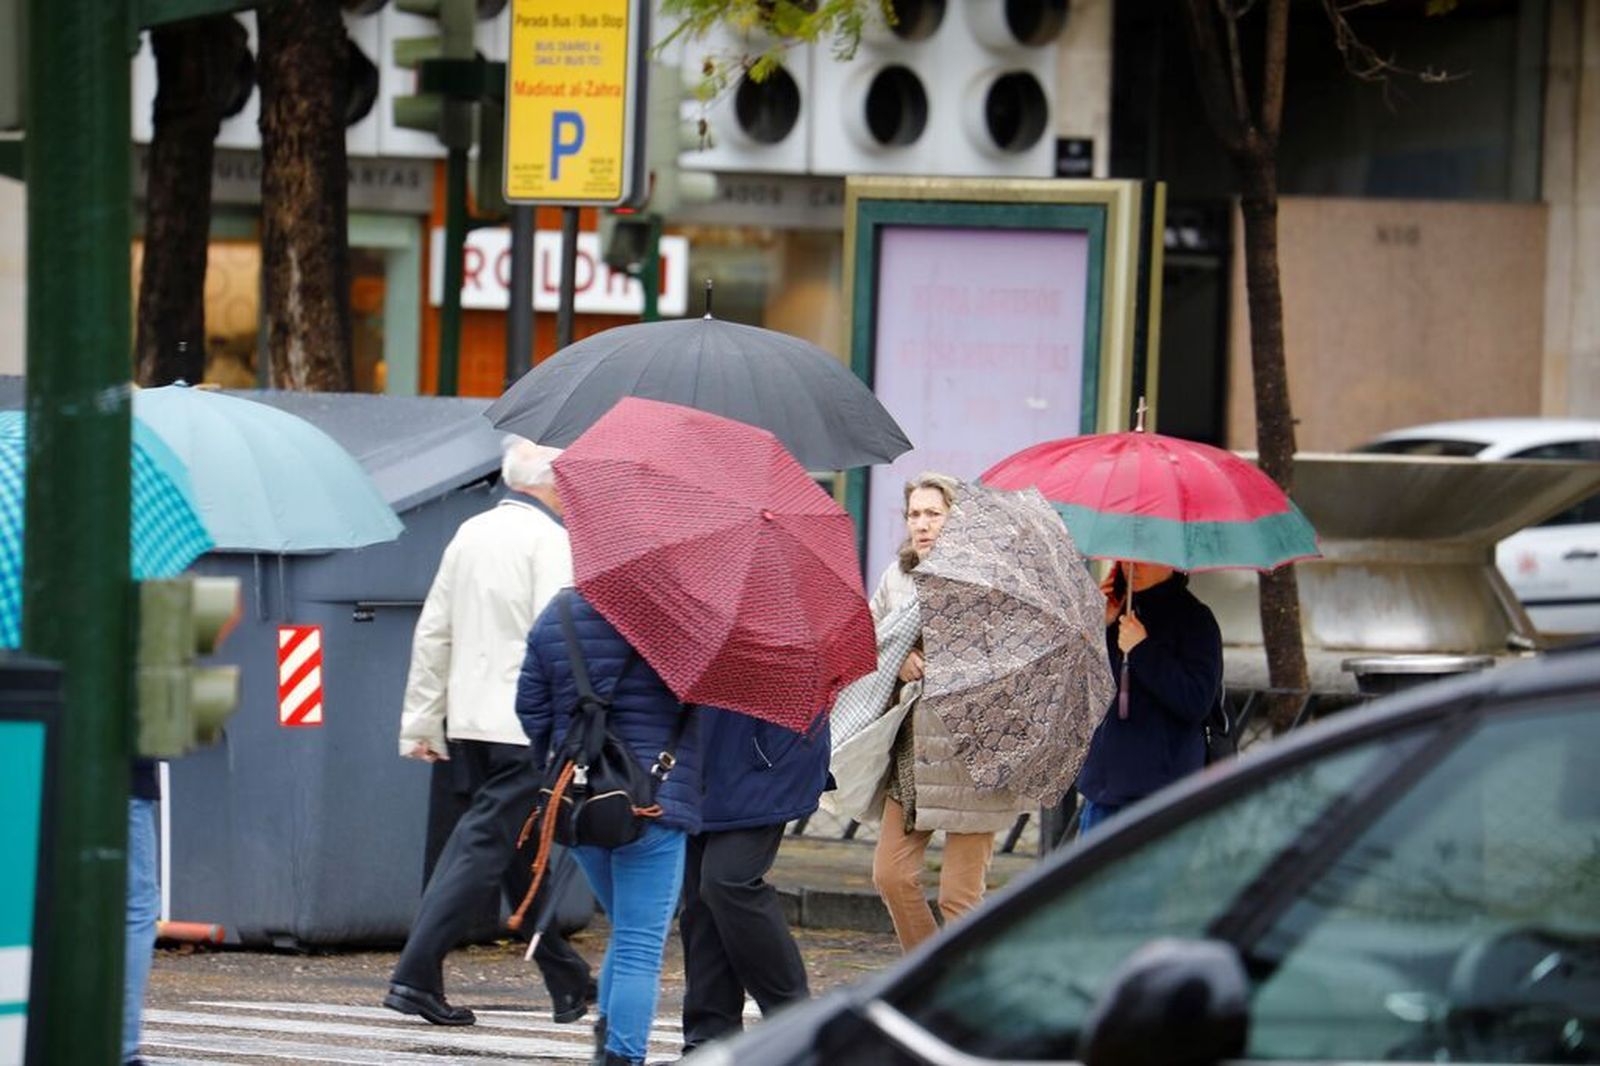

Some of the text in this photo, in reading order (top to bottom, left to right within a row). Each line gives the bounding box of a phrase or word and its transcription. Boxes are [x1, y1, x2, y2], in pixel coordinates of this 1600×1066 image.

[515, 13, 548, 27] Parada
[551, 13, 570, 27] Bus
[579, 13, 599, 28] Bus
[601, 13, 625, 30] Stop
[513, 79, 622, 97] Madinat al-Zahra
[550, 110, 585, 181] P
